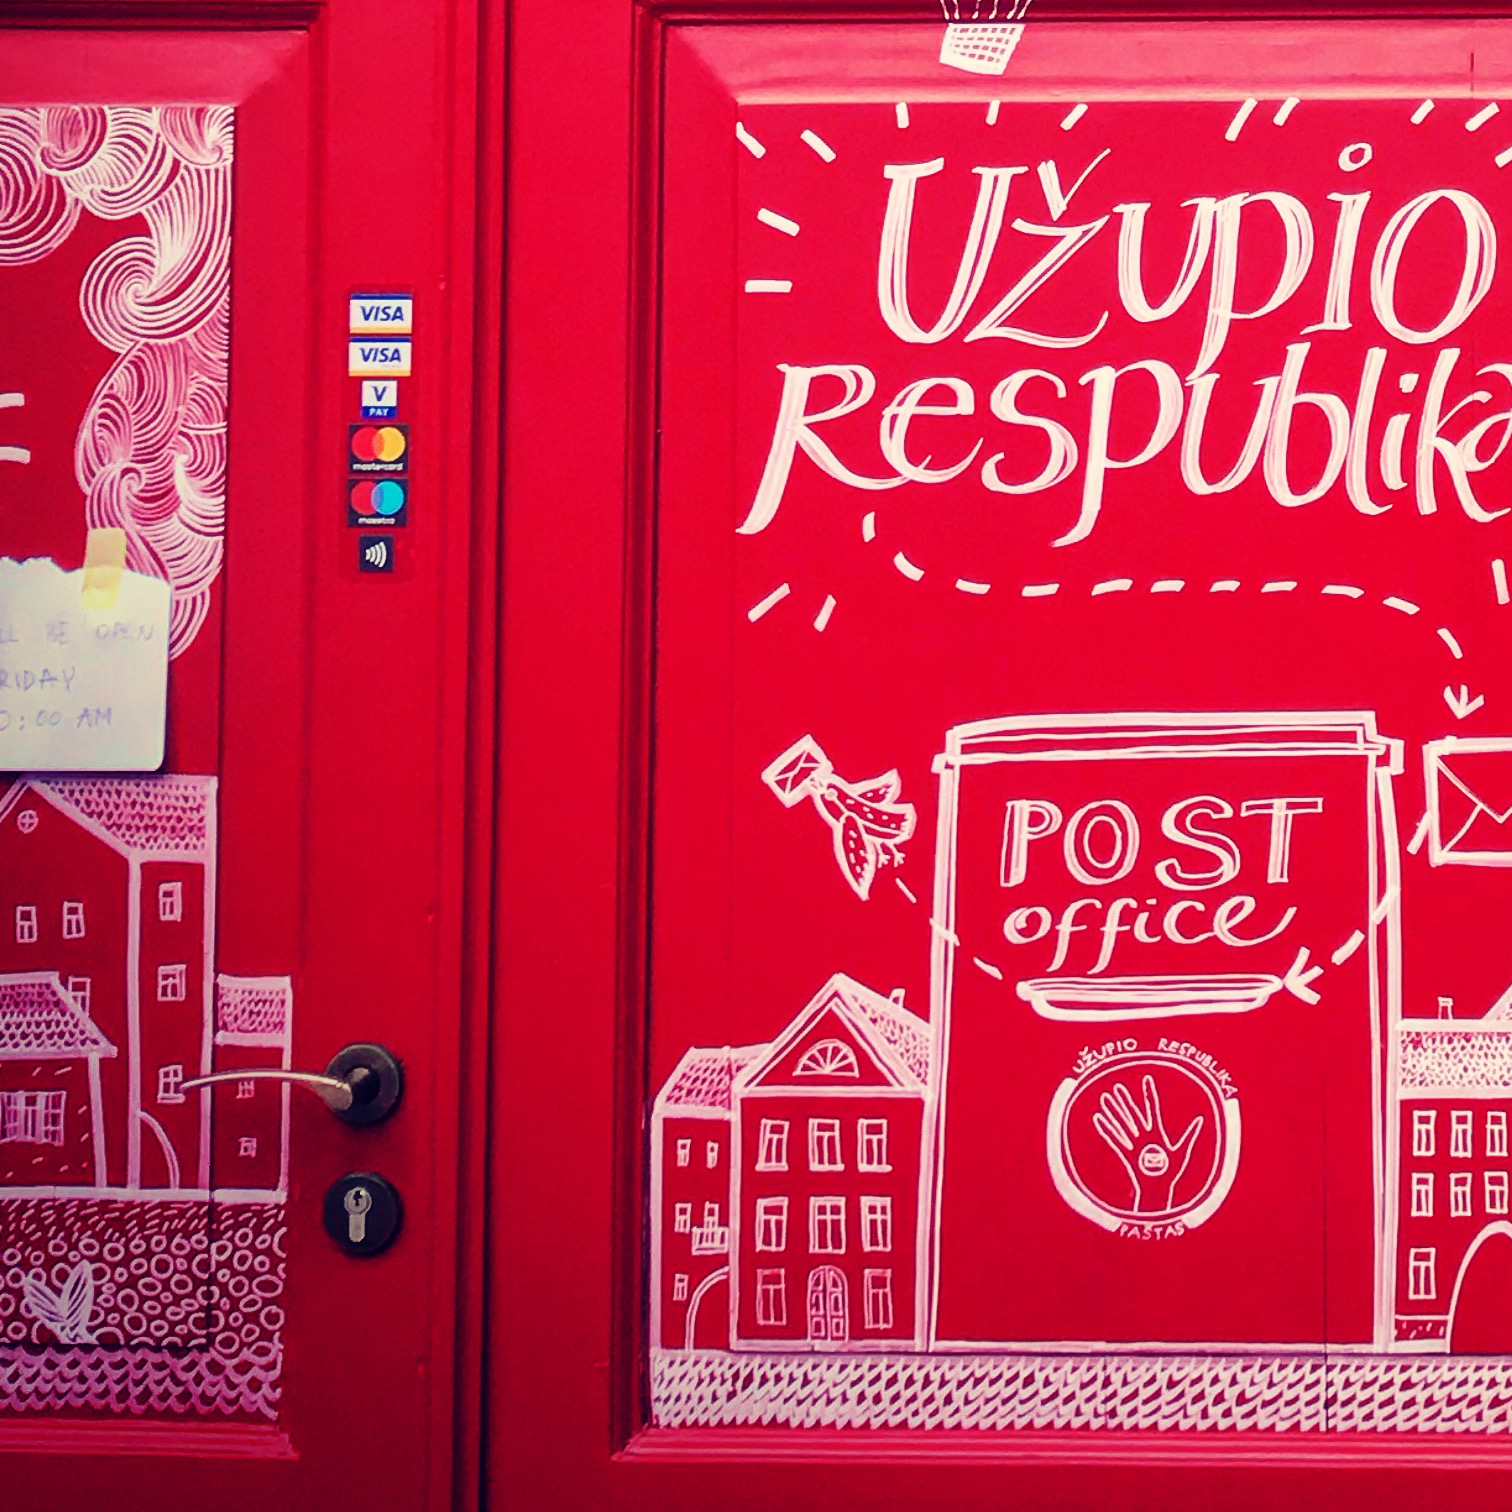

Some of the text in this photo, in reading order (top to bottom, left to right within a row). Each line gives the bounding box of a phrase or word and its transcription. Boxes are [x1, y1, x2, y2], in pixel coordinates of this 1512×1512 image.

[877, 143, 1497, 382] Užupio
[360, 306, 405, 321] VISA
[359, 347, 402, 363] VISA
[372, 385, 388, 402] V
[368, 408, 390, 417] PAY
[1000, 794, 1324, 891] POST
[1003, 894, 1297, 975] office
[1072, 1037, 1239, 1099] UŽUPIO RESPUBLIKA
[1119, 1221, 1187, 1241] PAŠTAS
